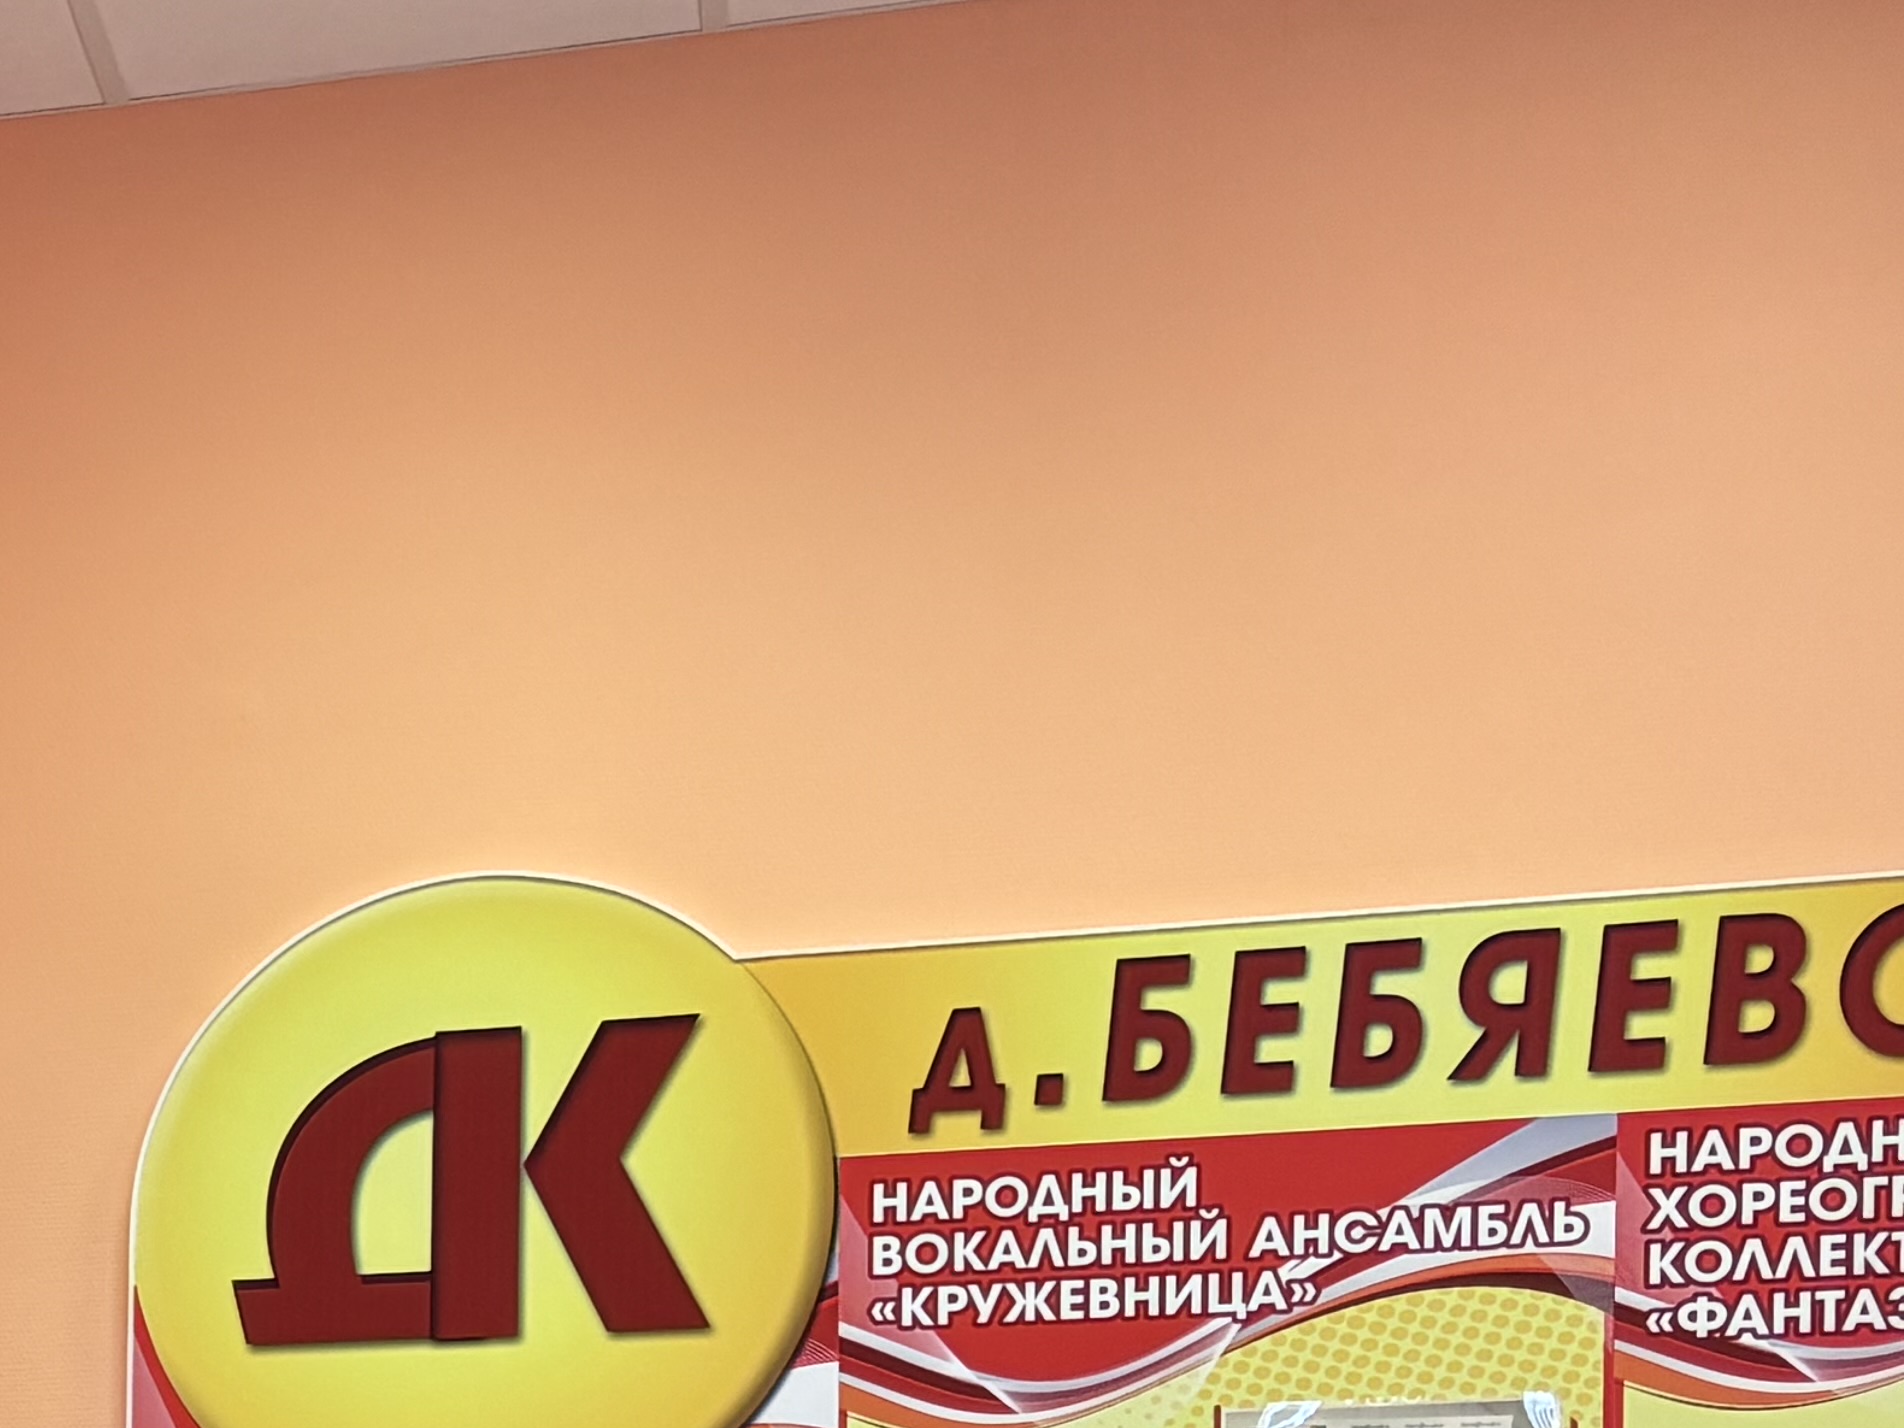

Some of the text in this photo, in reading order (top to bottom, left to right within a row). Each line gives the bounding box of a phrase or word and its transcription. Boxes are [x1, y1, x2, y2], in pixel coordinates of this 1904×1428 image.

[230, 1012, 715, 1348] ДК
[872, 1157, 1198, 1224] НАРОДНЫЙ
[870, 1200, 1593, 1278] ВОКАЛЬНЫЙ АНСАМБЛЬ
[870, 1270, 1319, 1330] «КРУЖЕВНИЦА»
